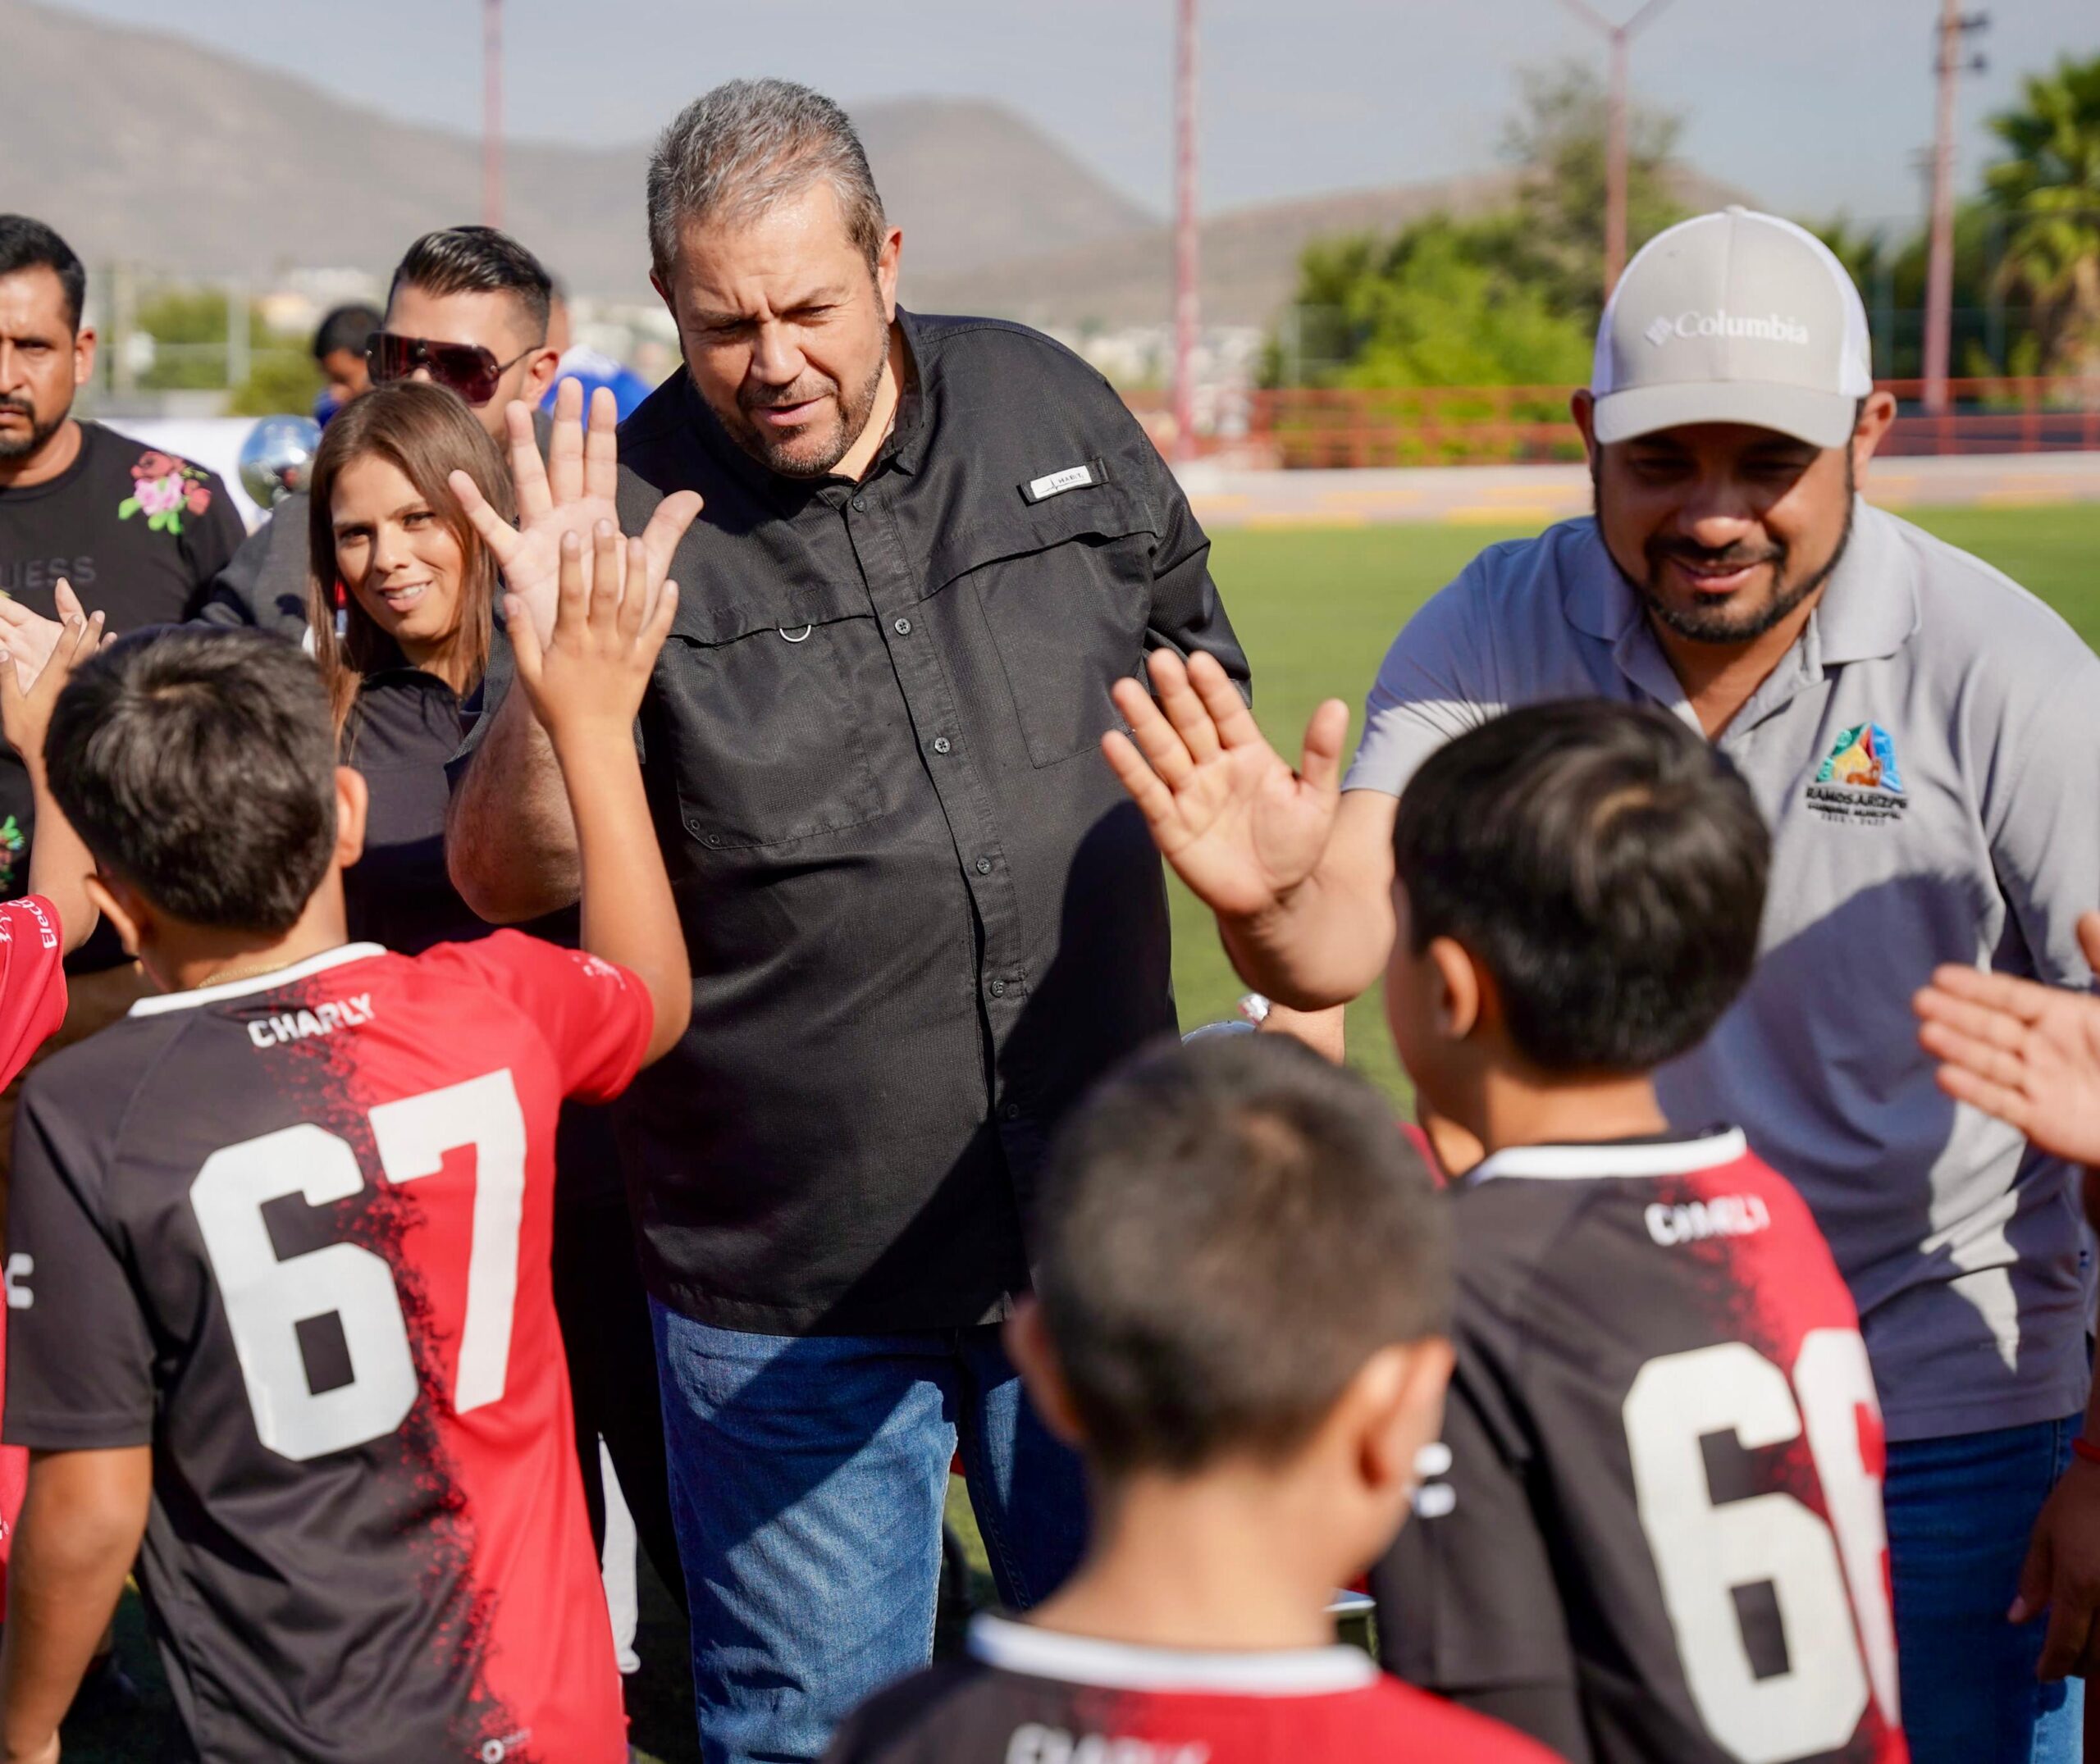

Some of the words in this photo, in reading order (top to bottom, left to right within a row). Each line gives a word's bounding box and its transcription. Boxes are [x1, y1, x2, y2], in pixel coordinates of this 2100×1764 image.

[1673, 309, 1810, 344] Columbia
[247, 991, 376, 1049] CHARLY
[189, 1067, 527, 1462] 67
